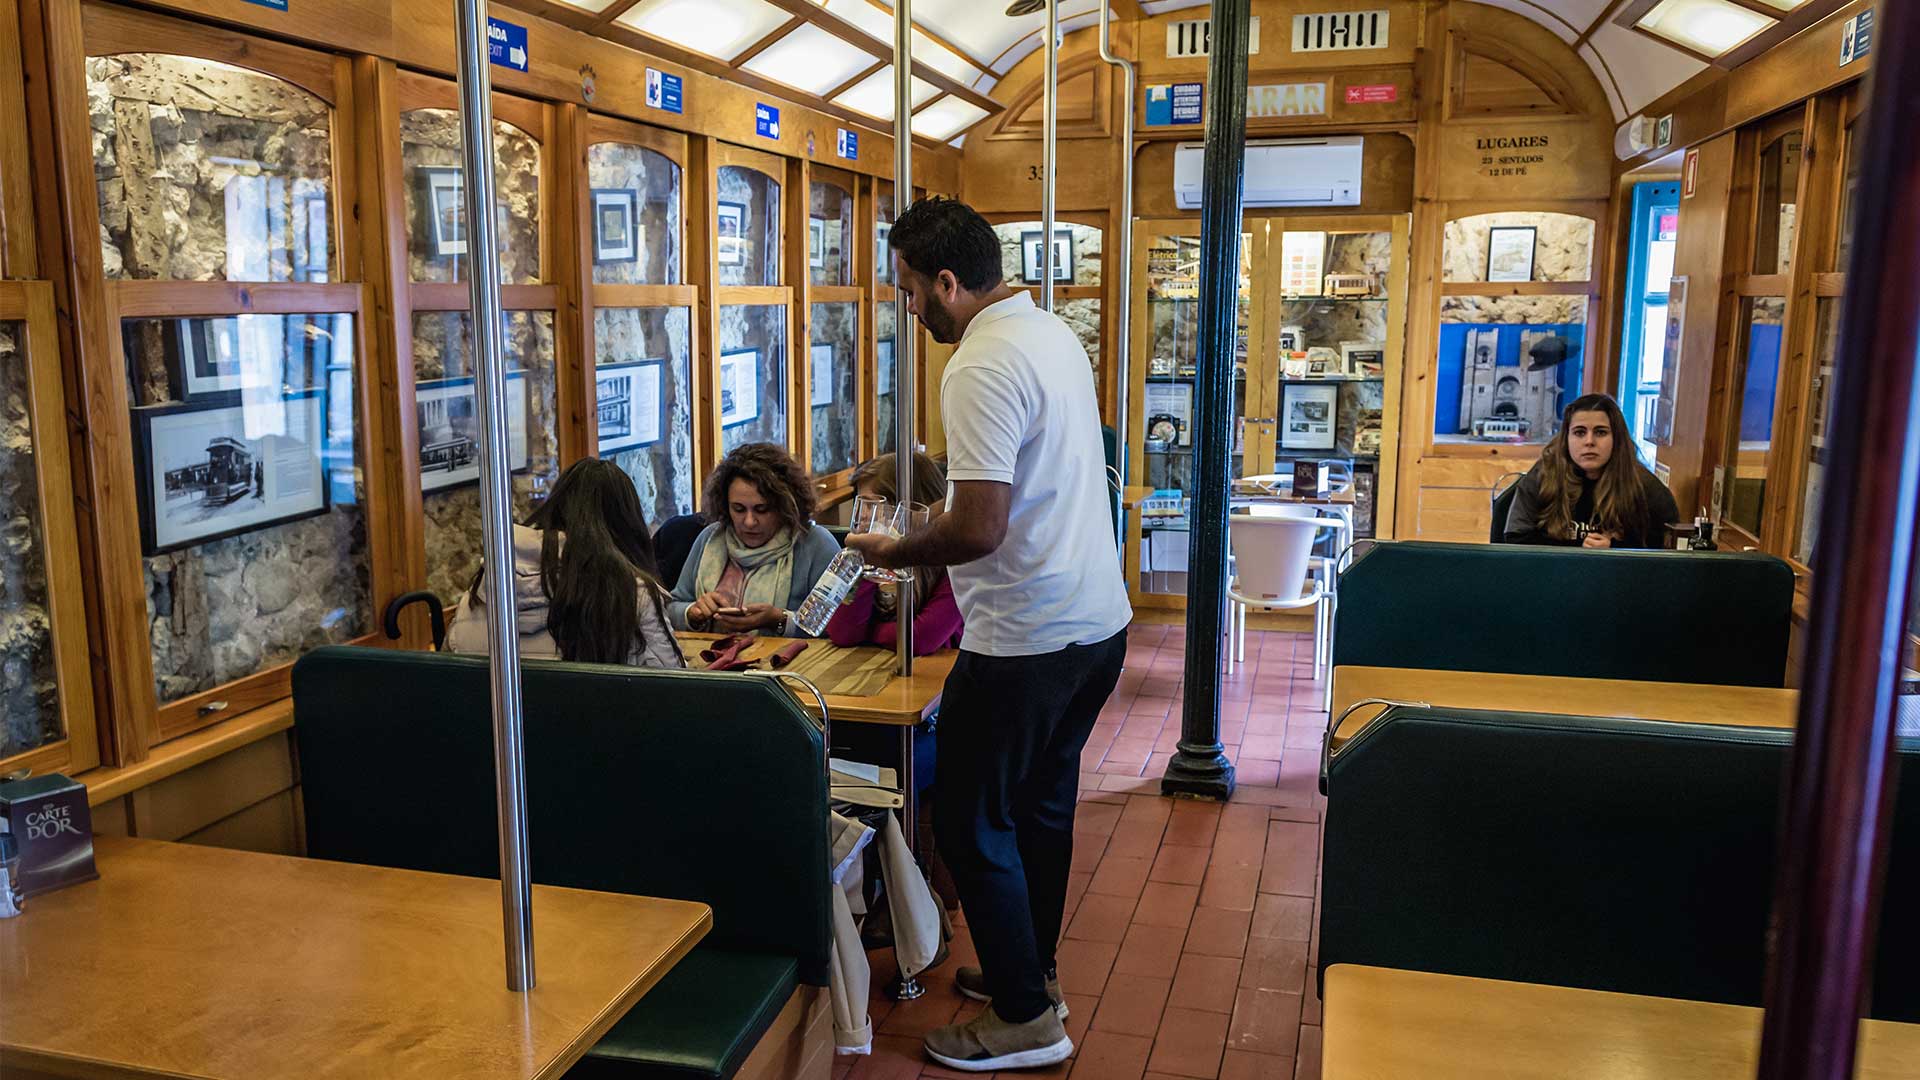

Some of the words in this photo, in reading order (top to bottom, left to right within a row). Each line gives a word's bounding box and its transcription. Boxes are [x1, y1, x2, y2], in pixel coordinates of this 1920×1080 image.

[488, 23, 508, 42] AÍDA
[1247, 86, 1320, 115] ARAR
[1477, 136, 1549, 149] LUGARES
[1499, 155, 1545, 164] SENTADOS
[1502, 168, 1514, 176] DE
[25, 805, 71, 826] CARTE
[27, 818, 83, 840] D'OR
